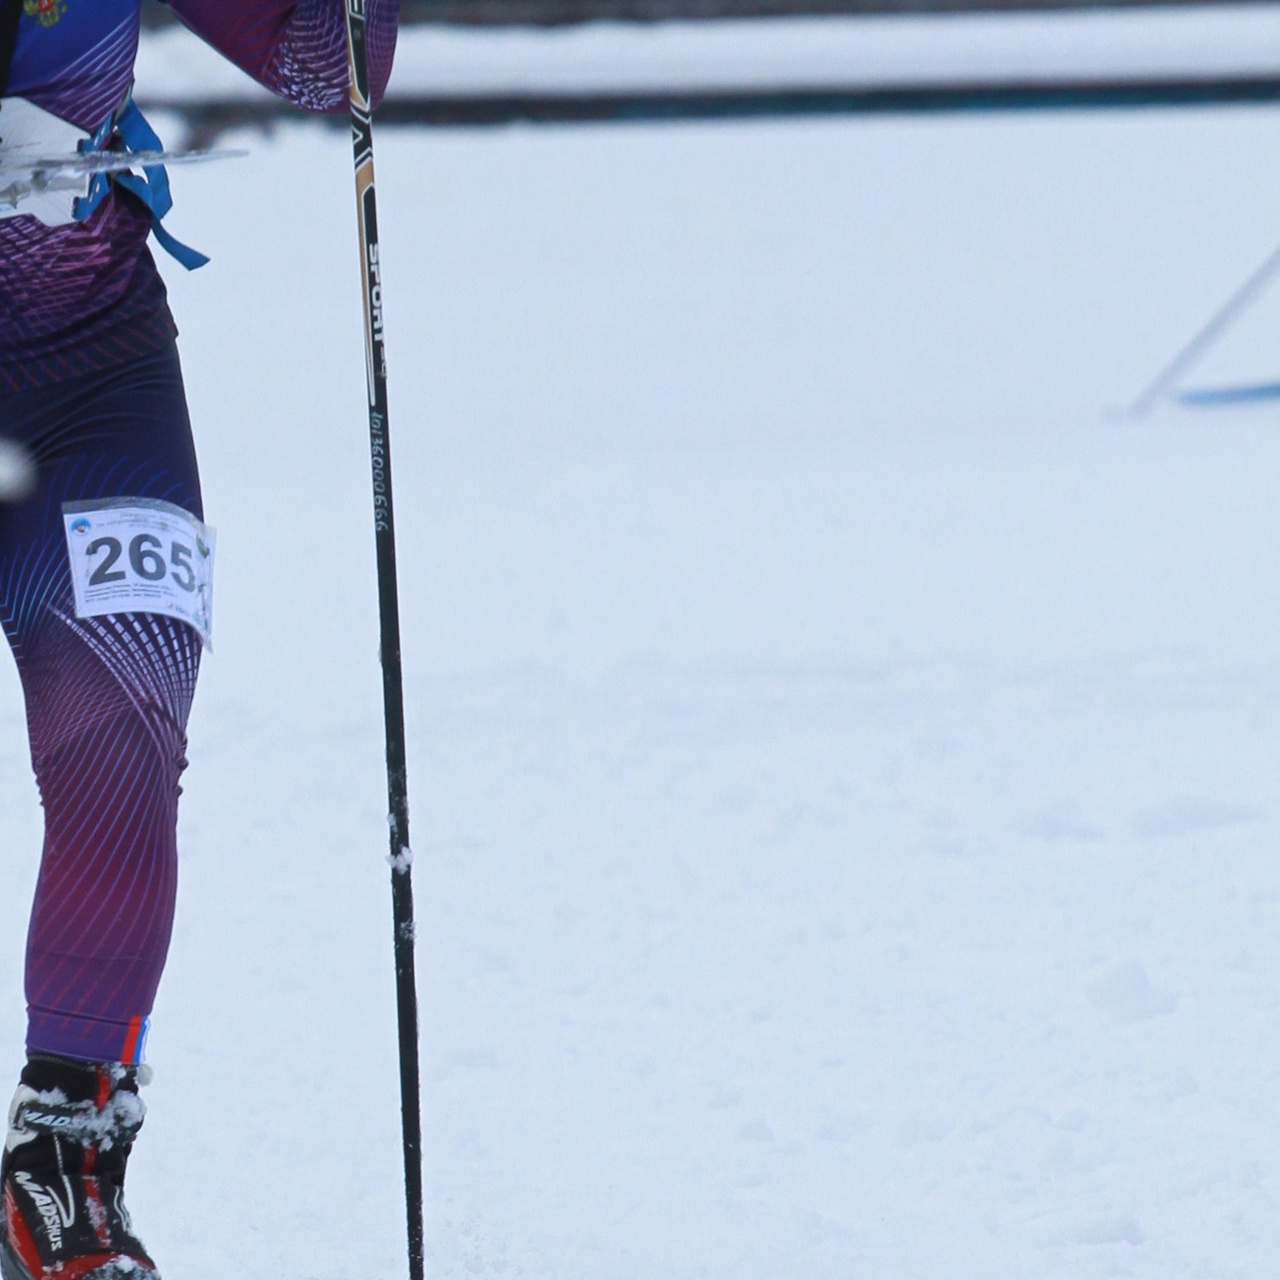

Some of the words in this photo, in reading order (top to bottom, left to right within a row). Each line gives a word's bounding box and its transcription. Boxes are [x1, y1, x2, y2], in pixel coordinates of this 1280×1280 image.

[368, 241, 386, 345] SPORT
[84, 533, 197, 595] 265
[14, 1170, 64, 1253] MADSHUS
